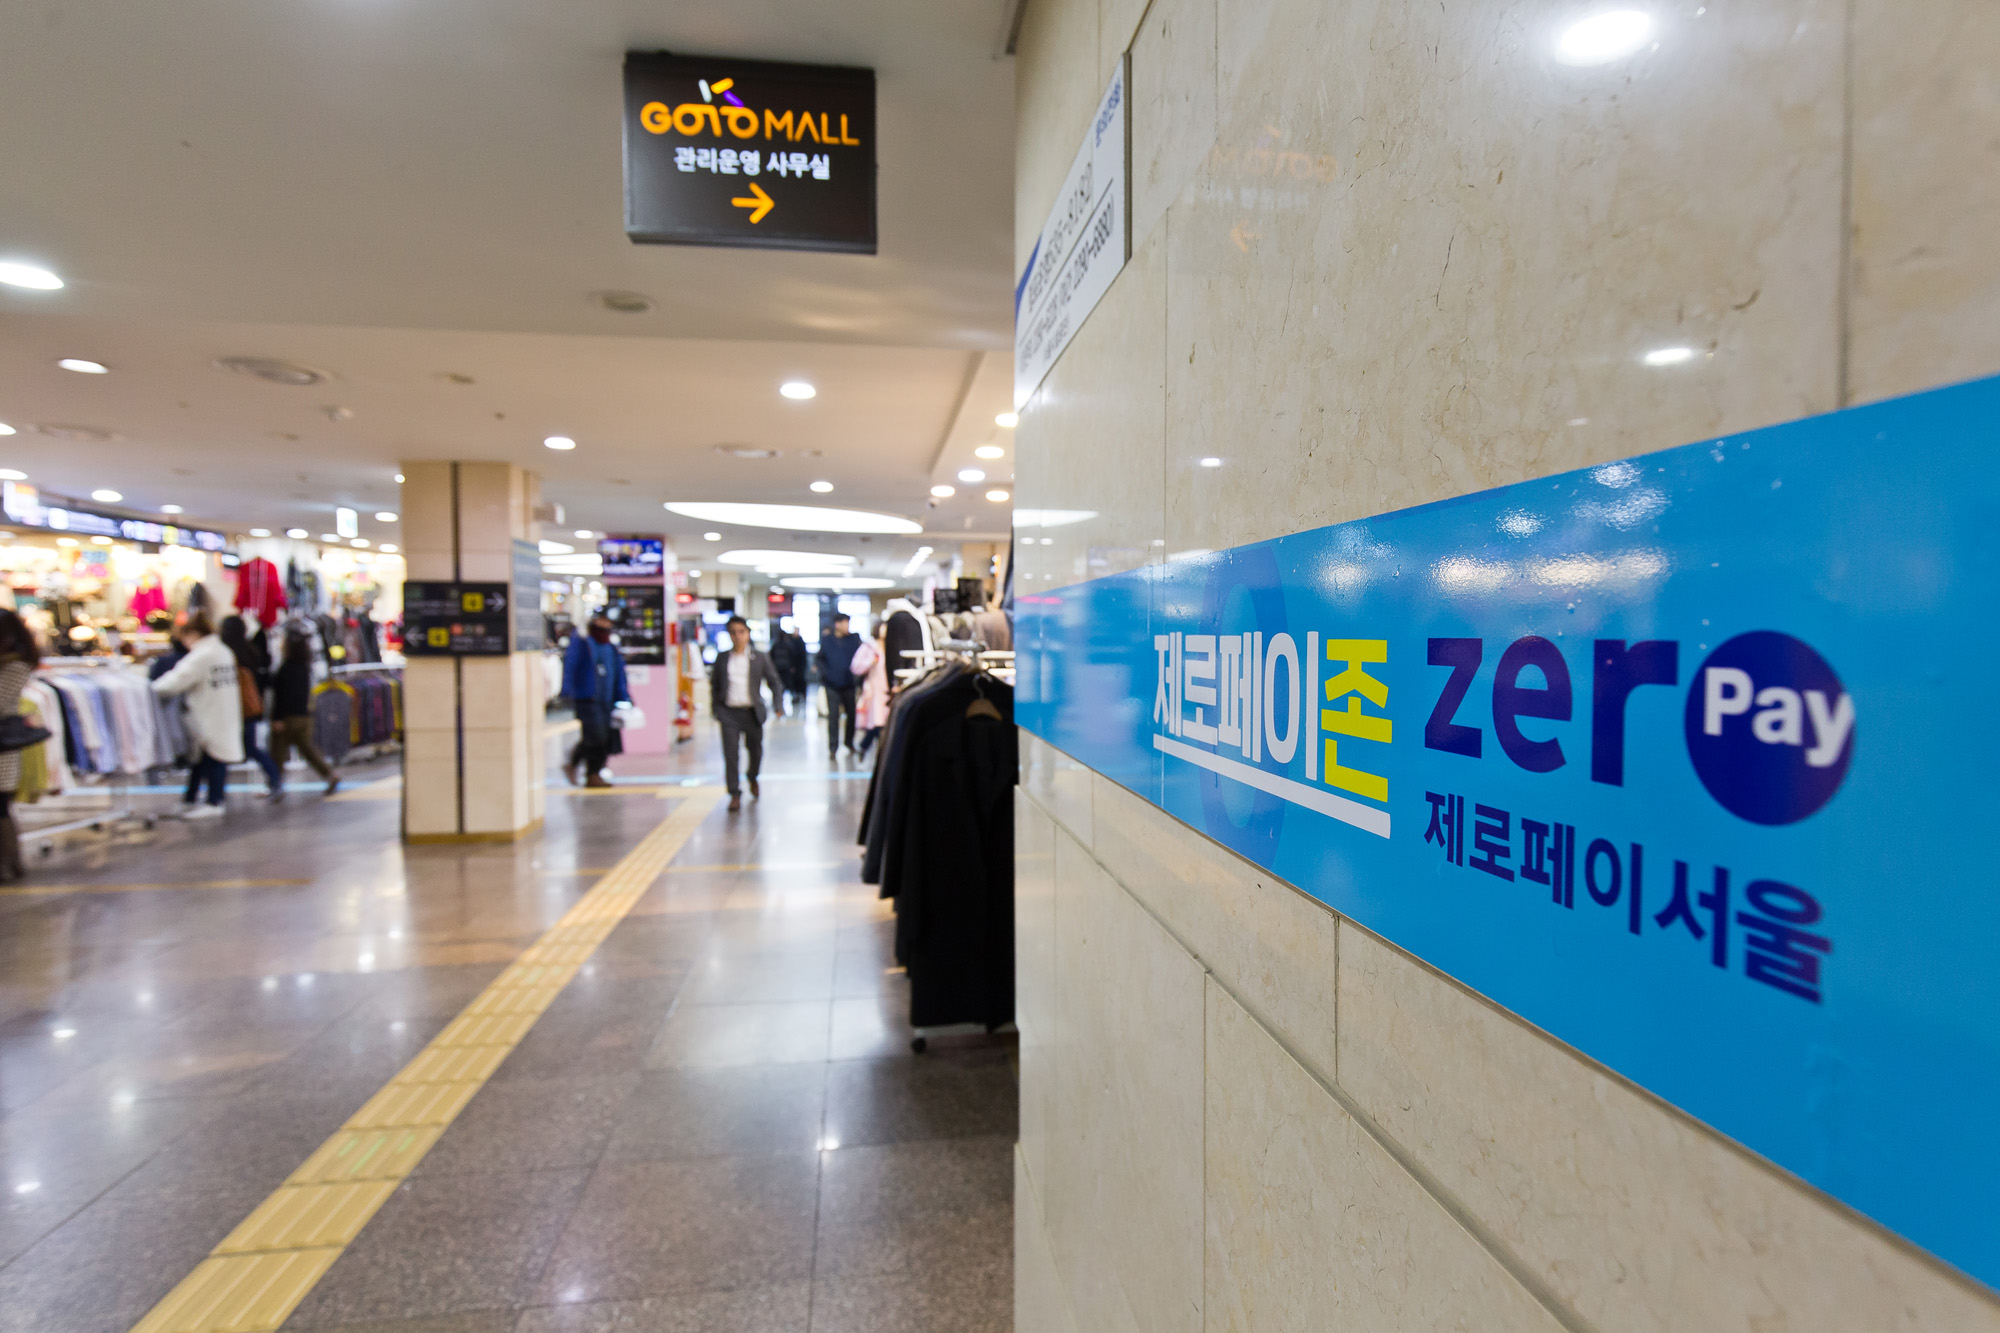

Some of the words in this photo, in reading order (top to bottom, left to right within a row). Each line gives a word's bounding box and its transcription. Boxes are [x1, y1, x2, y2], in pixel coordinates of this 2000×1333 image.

[640, 101, 759, 139] GOTO
[764, 108, 860, 146] MALL
[673, 146, 761, 176] 관리운영
[766, 151, 830, 180] 사무실
[1153, 631, 1392, 803] 제로페이존
[1704, 667, 1854, 767] Pay
